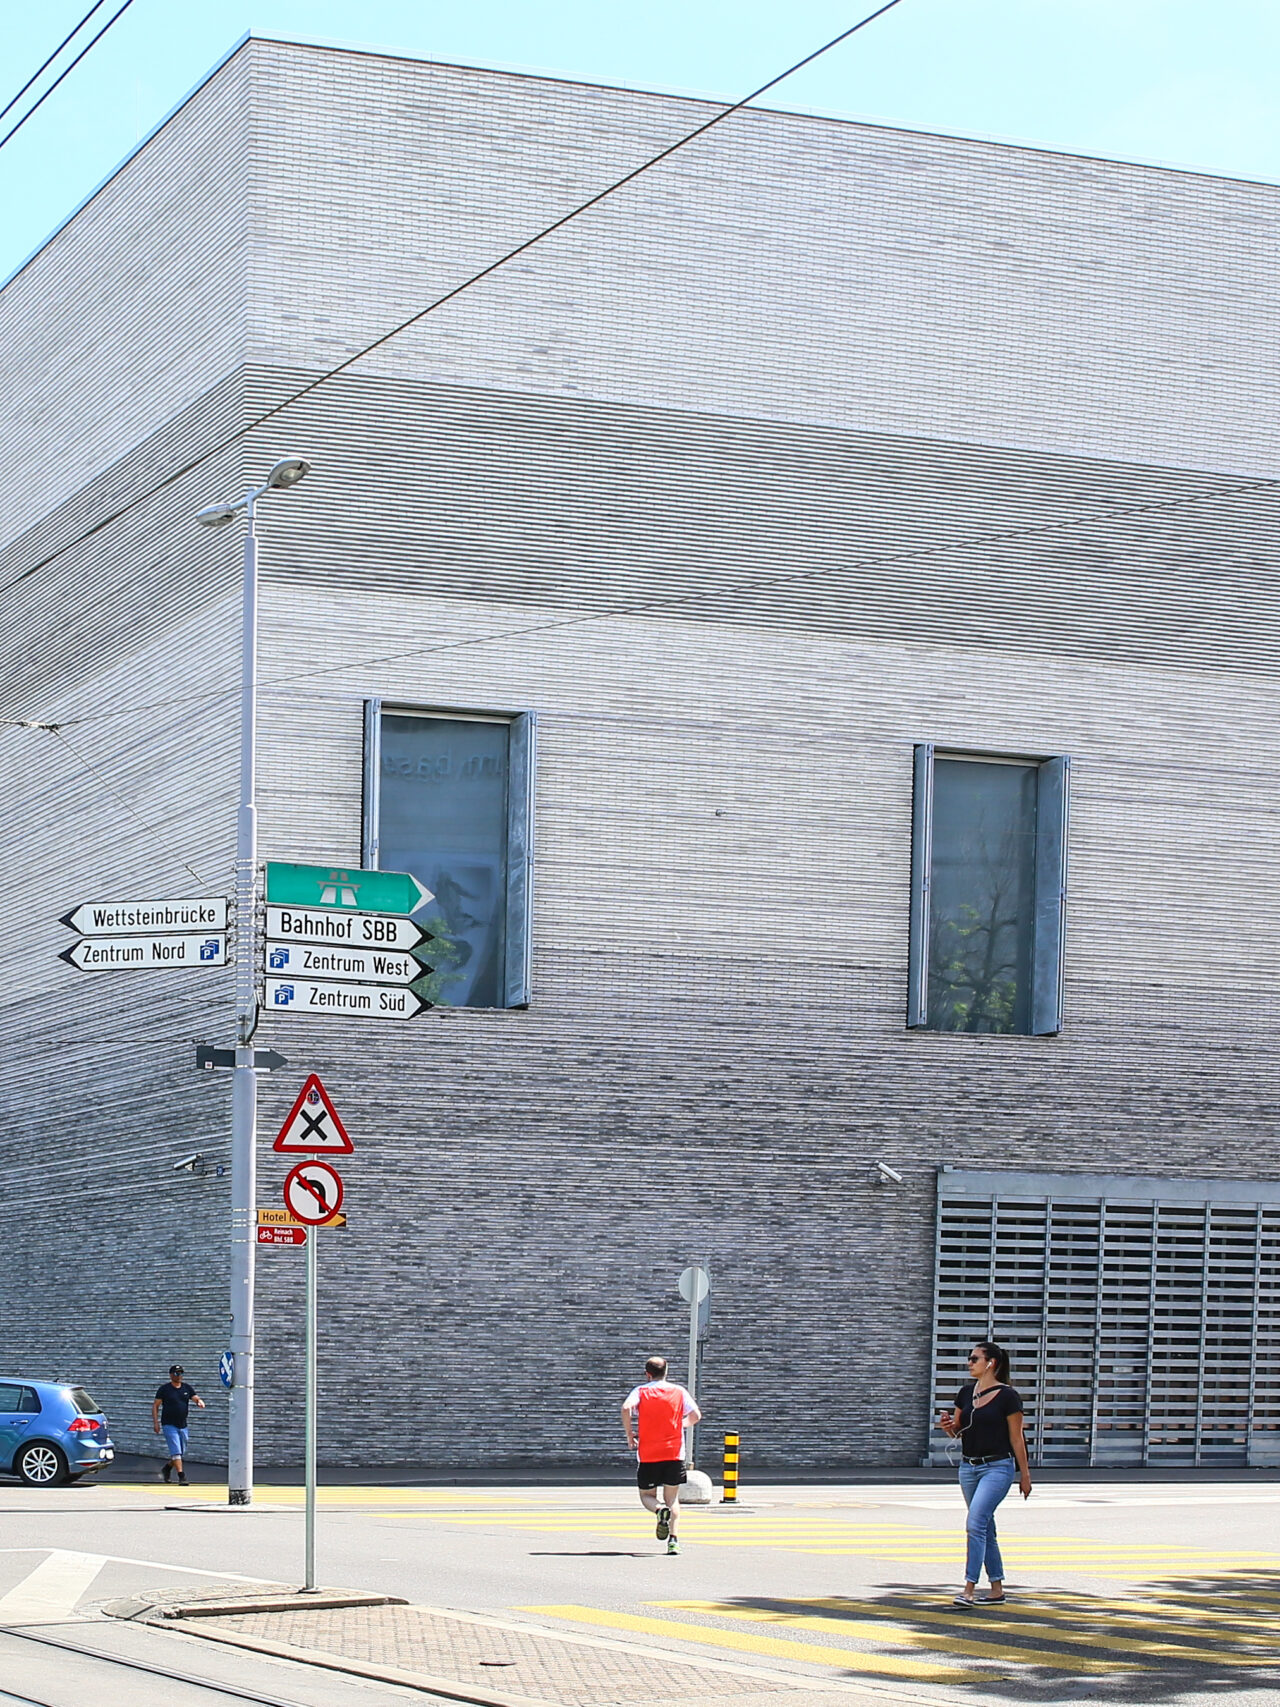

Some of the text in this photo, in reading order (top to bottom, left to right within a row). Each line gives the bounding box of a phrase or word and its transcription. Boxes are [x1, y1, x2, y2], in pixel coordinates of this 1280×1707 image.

[92, 904, 216, 927] Wettsteinbrücke
[281, 911, 397, 942] Bahnhof SBB
[83, 945, 144, 963] Zentrum
[152, 941, 185, 960] Nord
[303, 950, 365, 973] Zentrum
[373, 956, 409, 976] West
[309, 987, 371, 1009] Zentrum
[379, 992, 406, 1011] Süd
[262, 1212, 287, 1222] Hotel
